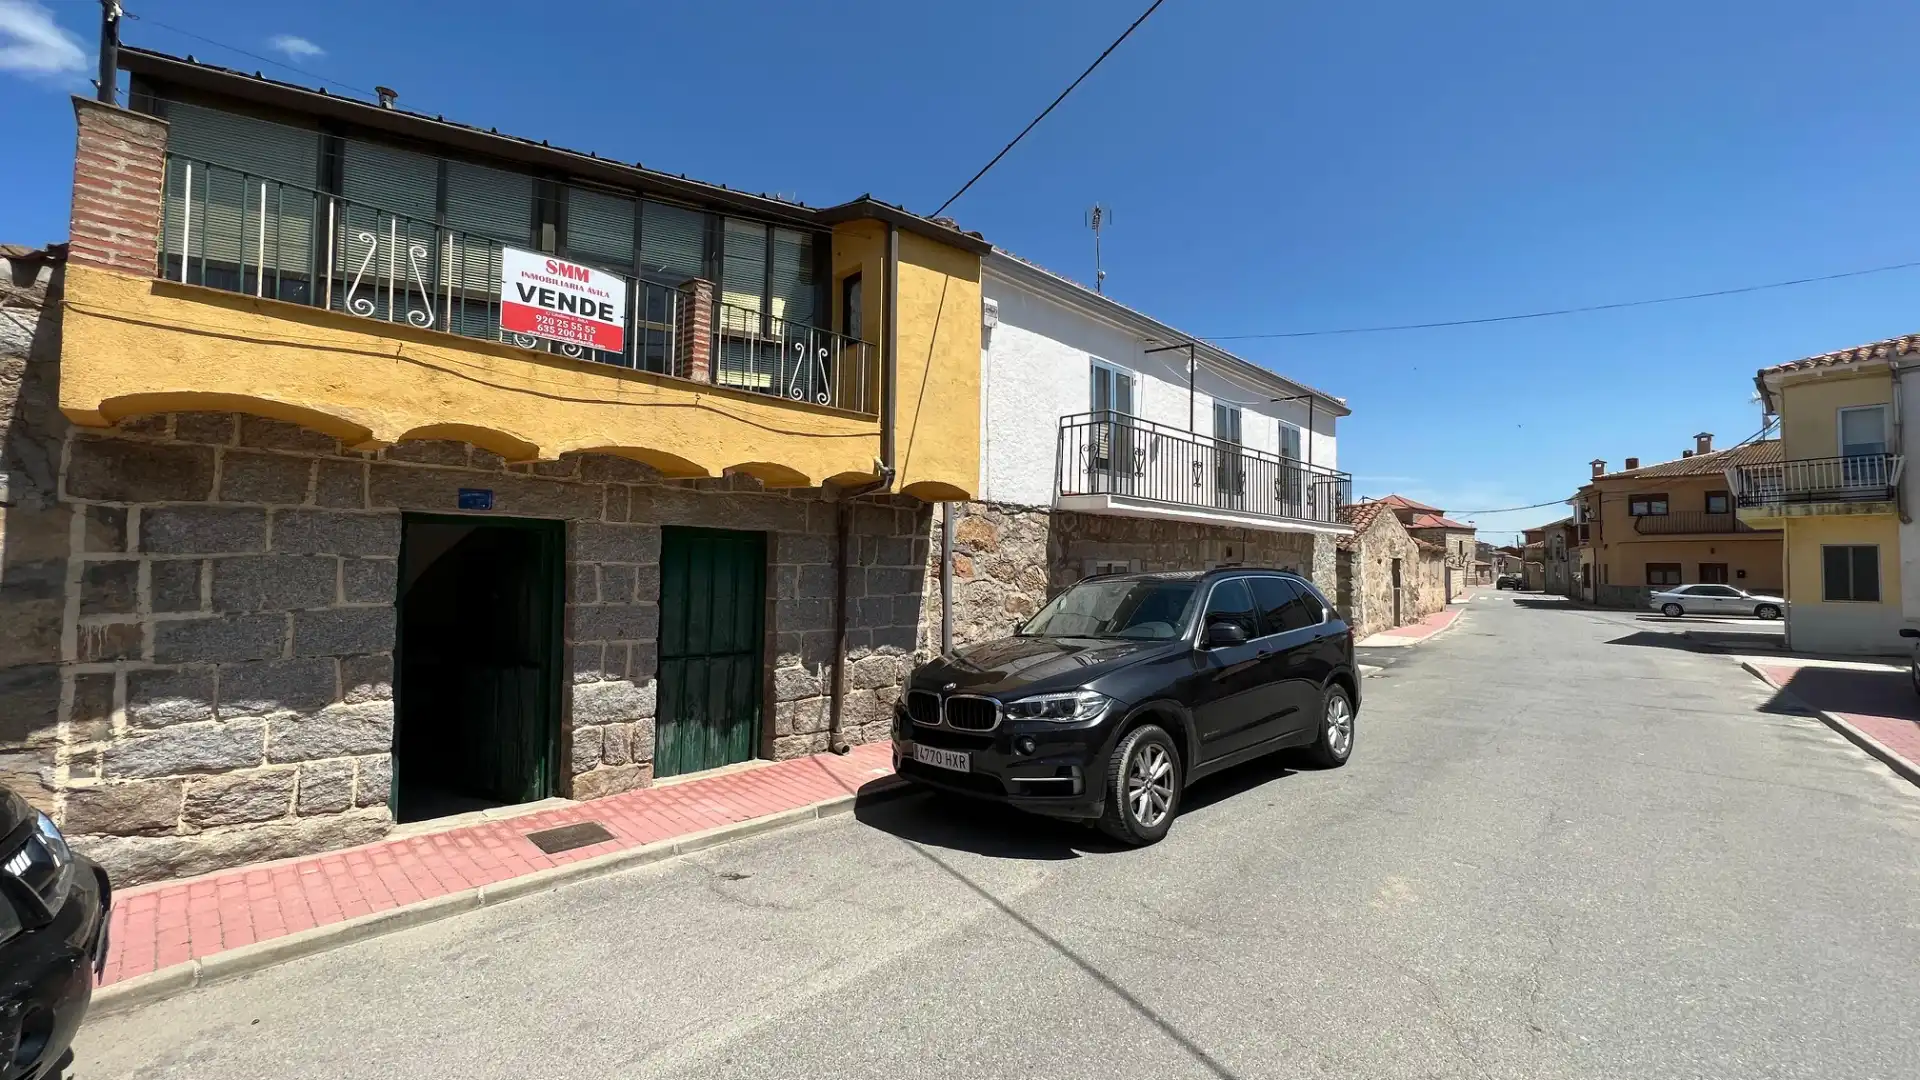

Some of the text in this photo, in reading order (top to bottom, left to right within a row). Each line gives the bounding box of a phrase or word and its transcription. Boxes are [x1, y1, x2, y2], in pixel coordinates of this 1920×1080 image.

[521, 271, 584, 292] INMOBILIARIA
[546, 259, 589, 283] SMM
[516, 281, 614, 322] VENDE
[535, 314, 554, 325] 920
[557, 319, 569, 329] 25
[571, 322, 582, 331] 55
[585, 325, 596, 334] 55
[537, 324, 555, 334] 635
[558, 328, 575, 338] 200
[577, 332, 593, 342] 411
[919, 747, 966, 769] 4770 HXR
